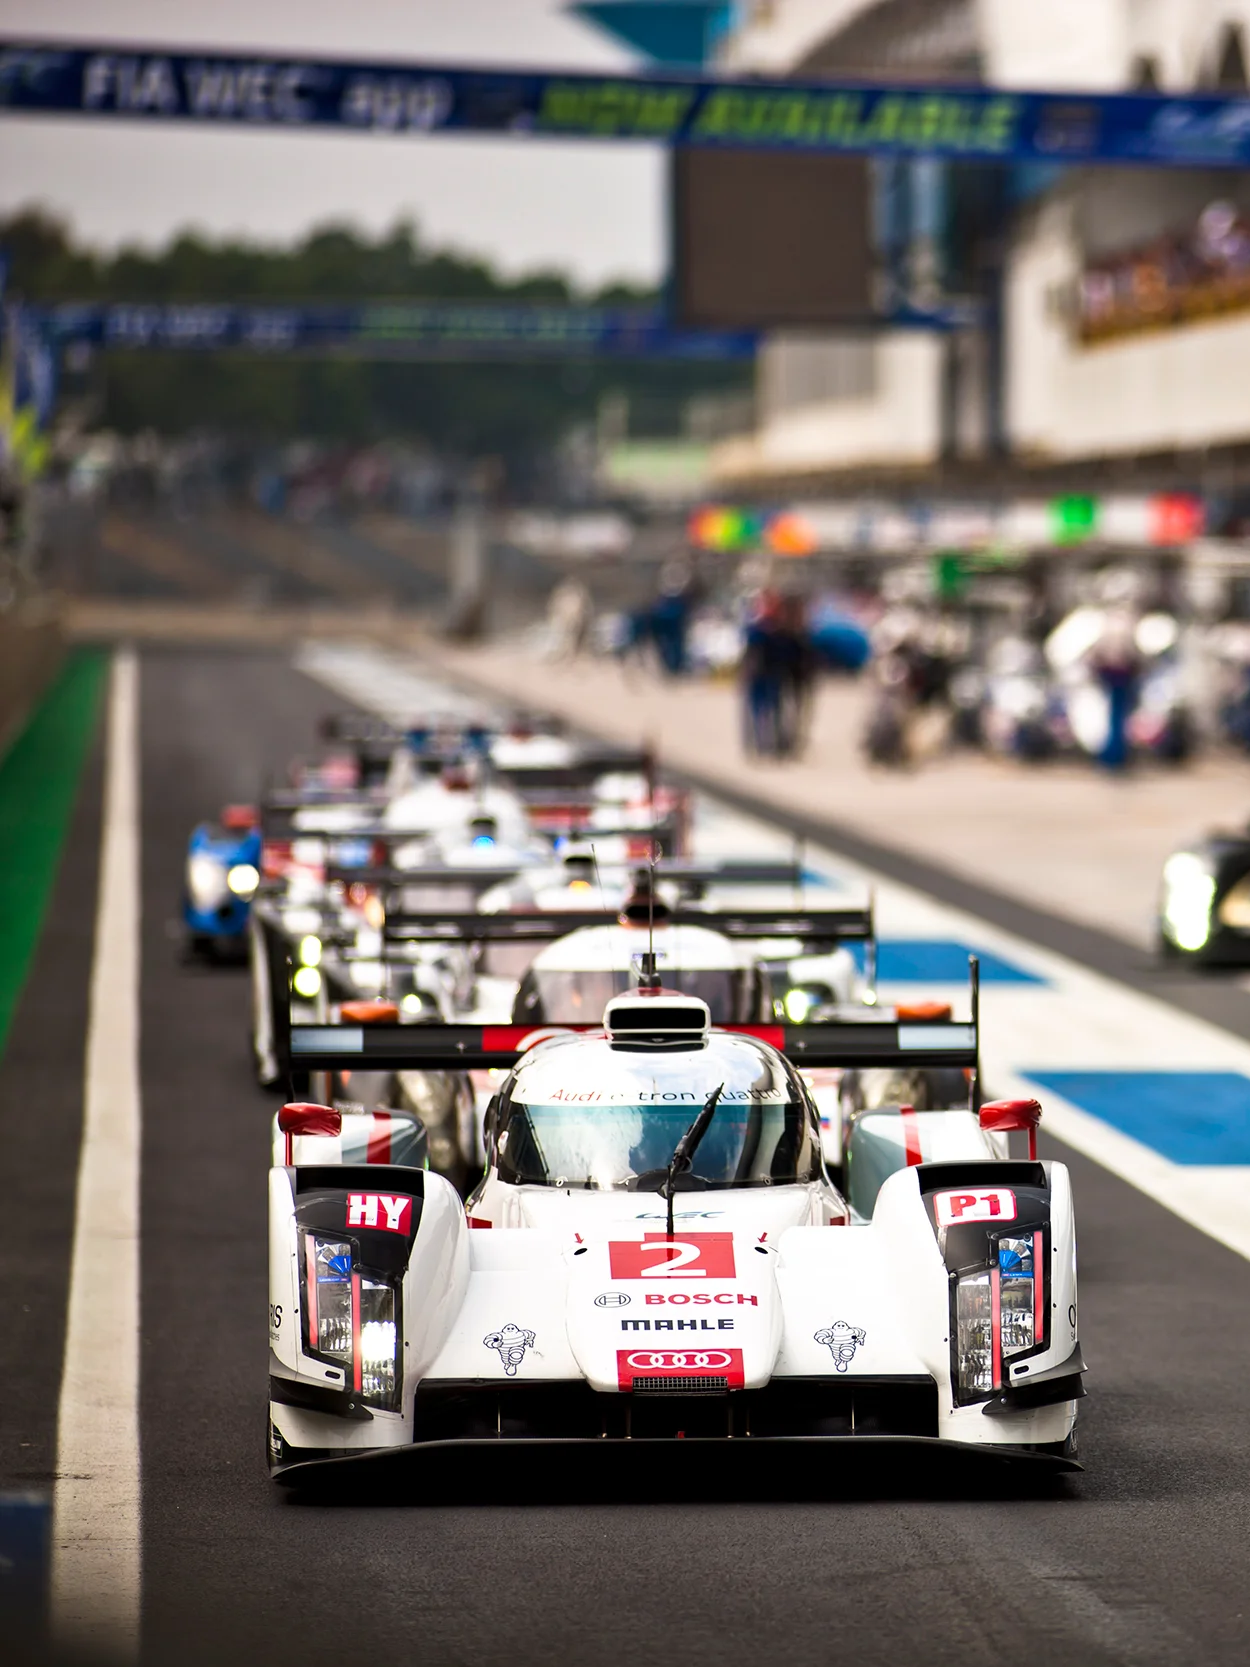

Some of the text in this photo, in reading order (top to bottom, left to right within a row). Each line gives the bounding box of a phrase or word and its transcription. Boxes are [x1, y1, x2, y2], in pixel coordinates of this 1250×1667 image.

[82, 56, 179, 112] FIA
[184, 64, 320, 122] WEC
[690, 90, 1017, 151] AVAILABLE
[549, 1088, 602, 1102] Audi
[349, 1195, 410, 1230] HY
[950, 1194, 1001, 1216] P1
[640, 1241, 707, 1277] 2
[645, 1293, 758, 1307] BOSCH
[621, 1318, 735, 1331] MAHLE
